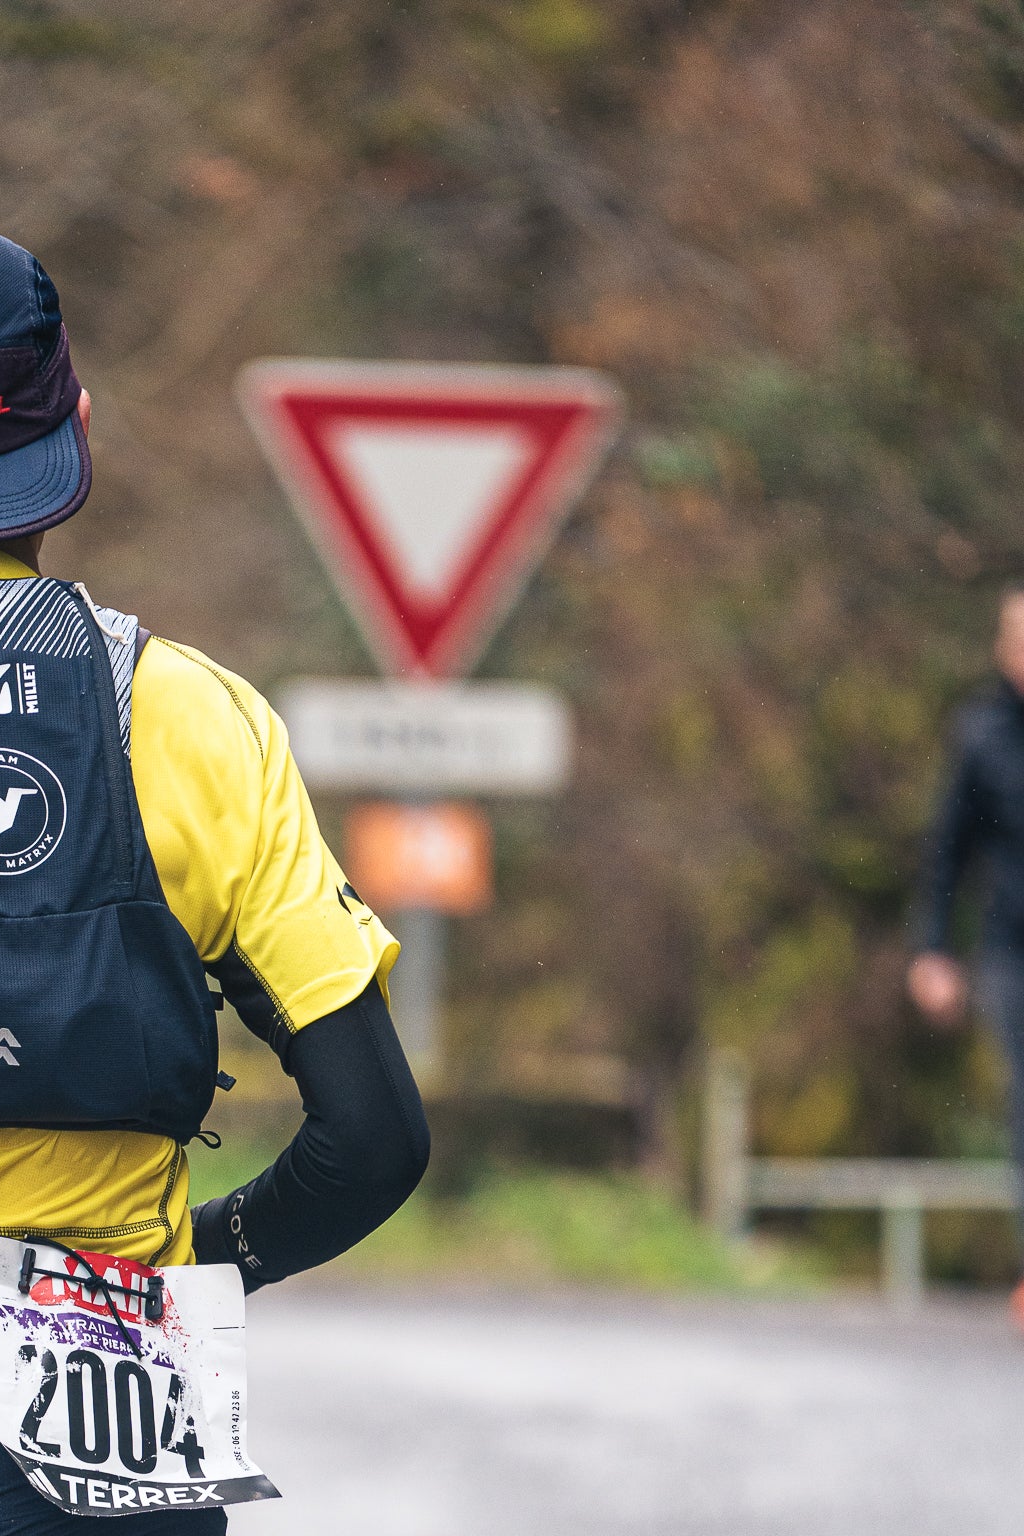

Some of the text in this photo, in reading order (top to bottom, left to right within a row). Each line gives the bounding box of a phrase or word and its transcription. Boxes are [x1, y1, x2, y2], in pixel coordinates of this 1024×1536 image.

[22, 662, 39, 714] MILLET
[6, 833, 54, 868] MATRYX
[63, 1318, 113, 1337] TRAIL
[232, 1390, 240, 1400] 86
[232, 1401, 240, 1411] 23
[15, 1343, 207, 1479] 2004
[232, 1435, 240, 1445] 06
[60, 1472, 225, 1510] TERREX
